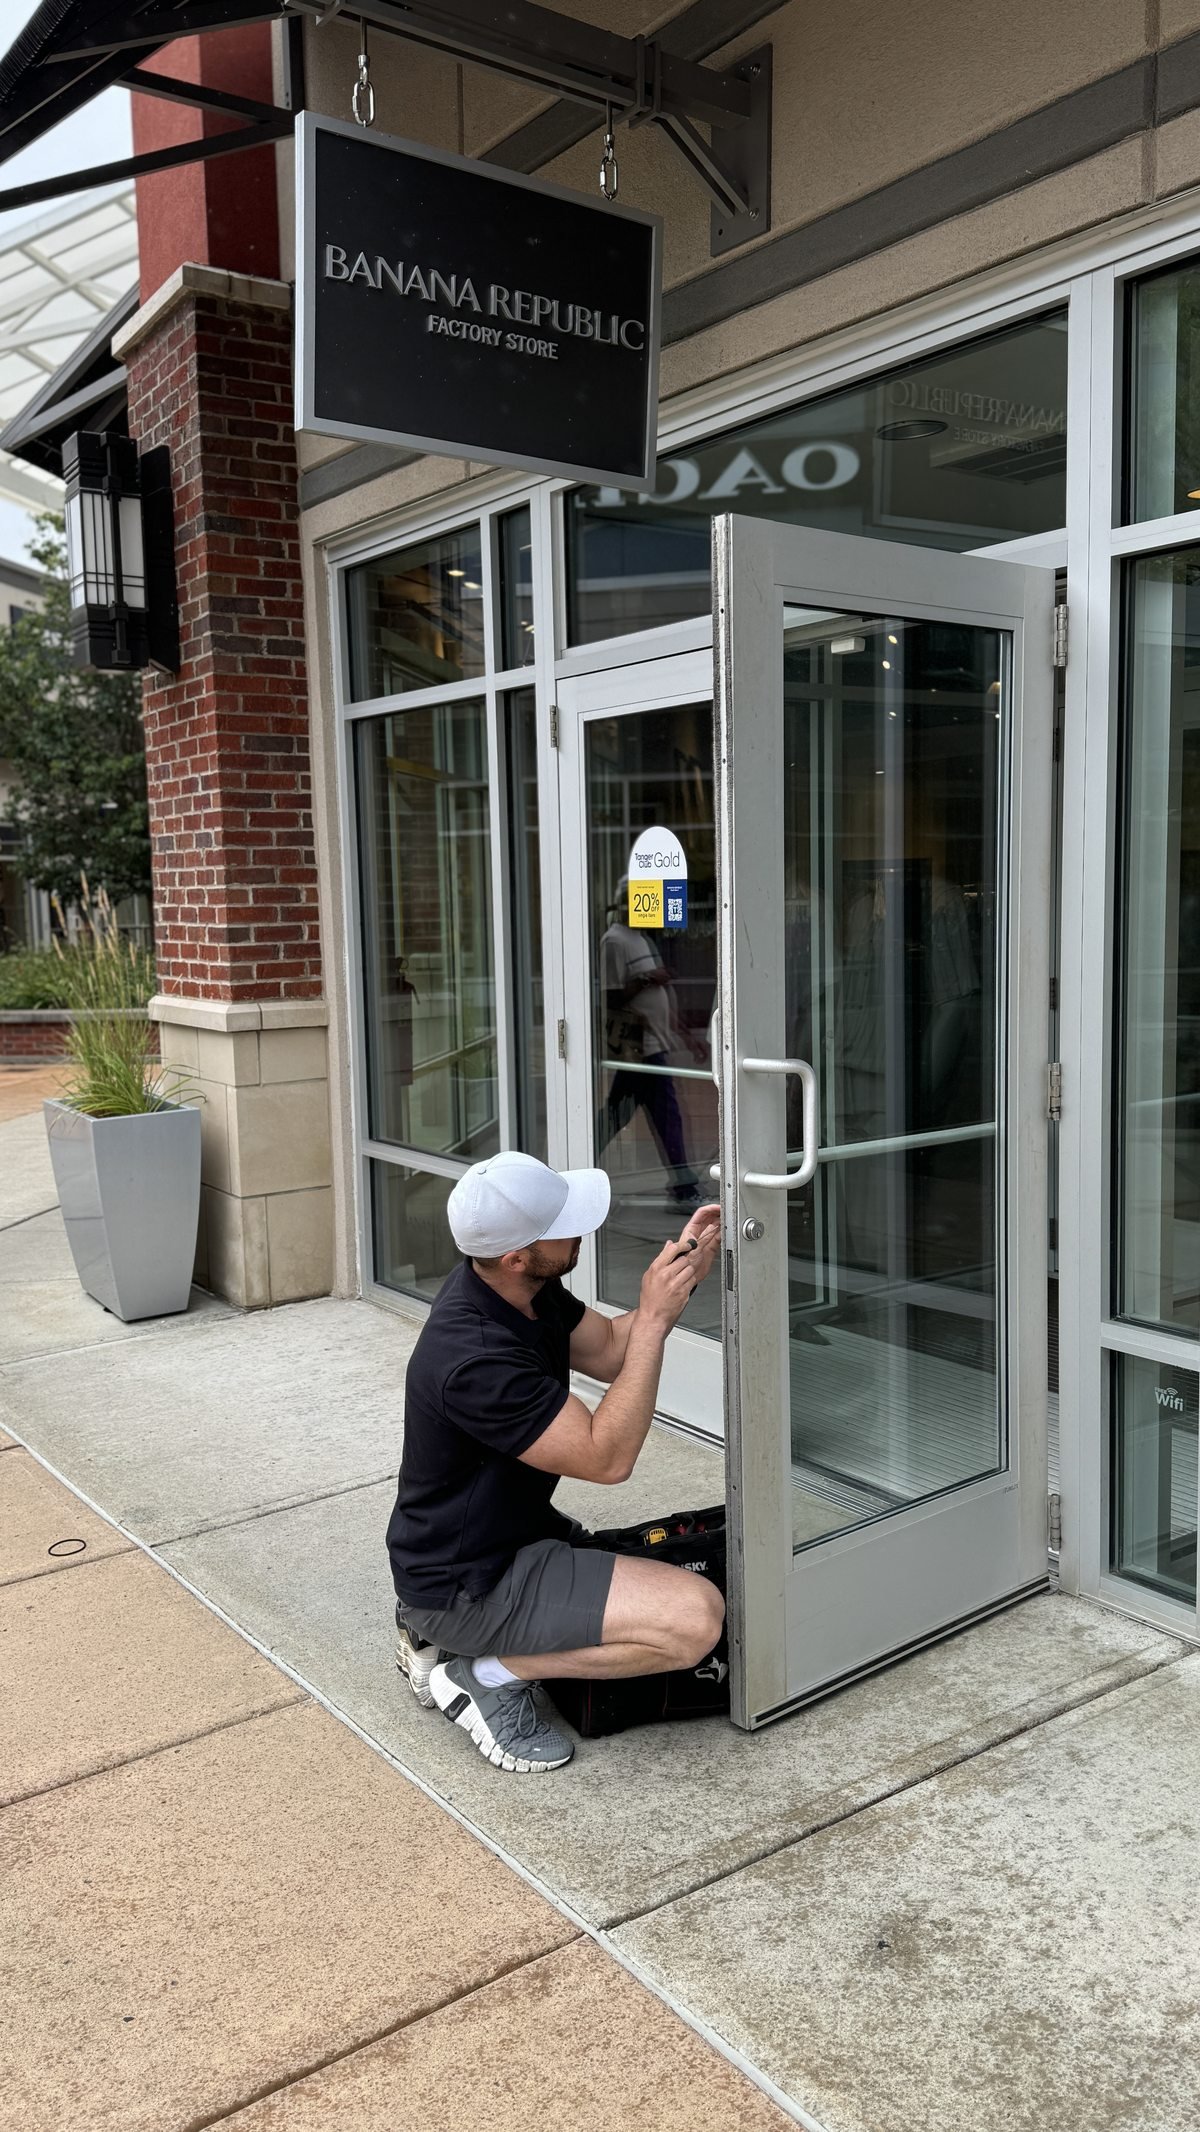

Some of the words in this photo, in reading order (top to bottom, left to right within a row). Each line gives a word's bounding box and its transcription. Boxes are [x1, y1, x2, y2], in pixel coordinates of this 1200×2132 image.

[324, 243, 482, 312] BANANA
[488, 283, 646, 350] REPUBLIC
[427, 314, 503, 346] FACTORY
[505, 333, 559, 359] STORE
[635, 852, 653, 861] Tanger
[654, 851, 680, 868] Gold
[633, 892, 660, 912] 20%
[1155, 1392, 1184, 1412] Wifi
